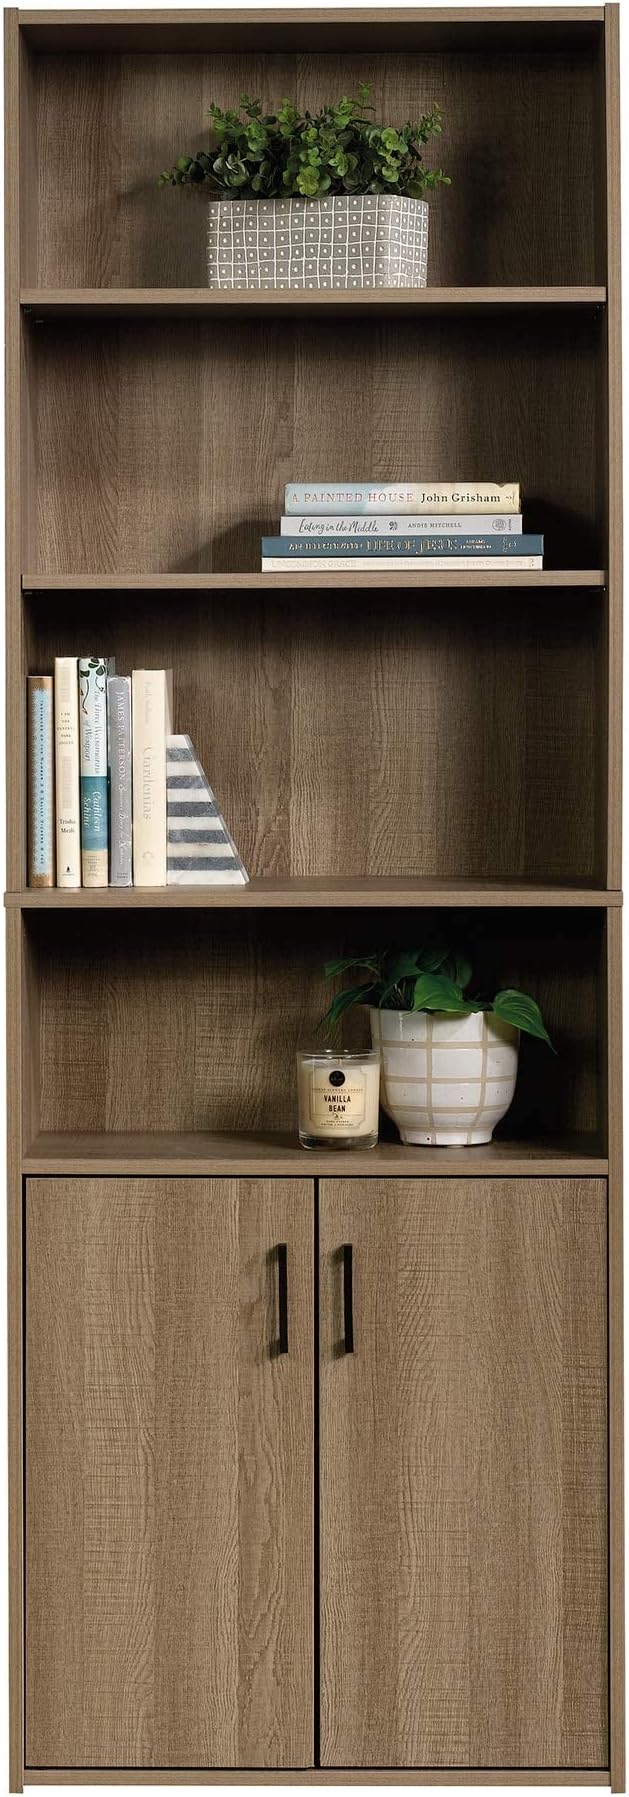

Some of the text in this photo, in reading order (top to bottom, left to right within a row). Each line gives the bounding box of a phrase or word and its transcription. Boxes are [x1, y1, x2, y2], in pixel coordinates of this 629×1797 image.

[292, 493, 501, 503] A PAINTED HOUSE John Grisham
[298, 518, 325, 534] Eating
[334, 521, 348, 532] the
[348, 520, 379, 533] Middle
[429, 521, 462, 529] MITCHELL
[366, 540, 395, 552] LIFE
[397, 539, 416, 551] OF
[416, 538, 458, 555] JESUS
[94, 704, 103, 724] Three
[115, 692, 126, 780] JAMES PATTERSON
[83, 729, 92, 762] Westport
[143, 747, 157, 820] Gardenias
[92, 791, 102, 833] Cathleen
[323, 1095, 351, 1103] VANILLA
